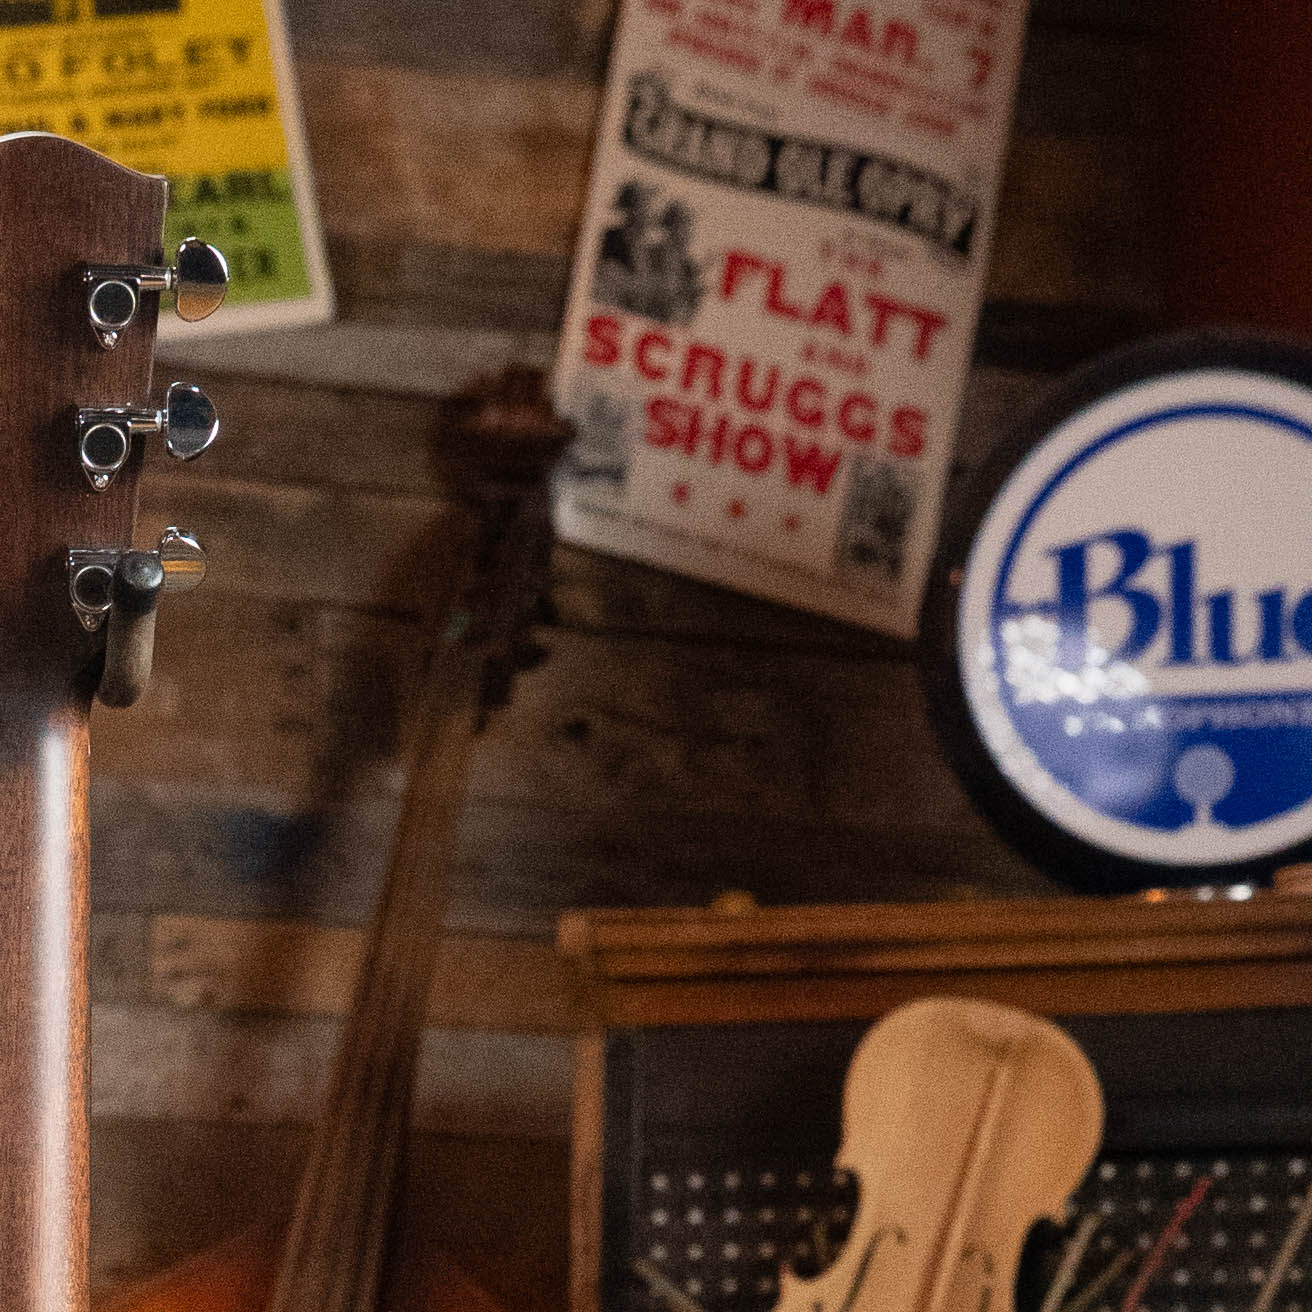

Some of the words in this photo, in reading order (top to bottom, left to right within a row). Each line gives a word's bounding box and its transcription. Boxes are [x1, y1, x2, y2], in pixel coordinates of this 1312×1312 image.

[720, 249, 948, 362] FLATT
[584, 313, 930, 458] SCRUGGS
[646, 395, 843, 495] SHOW
